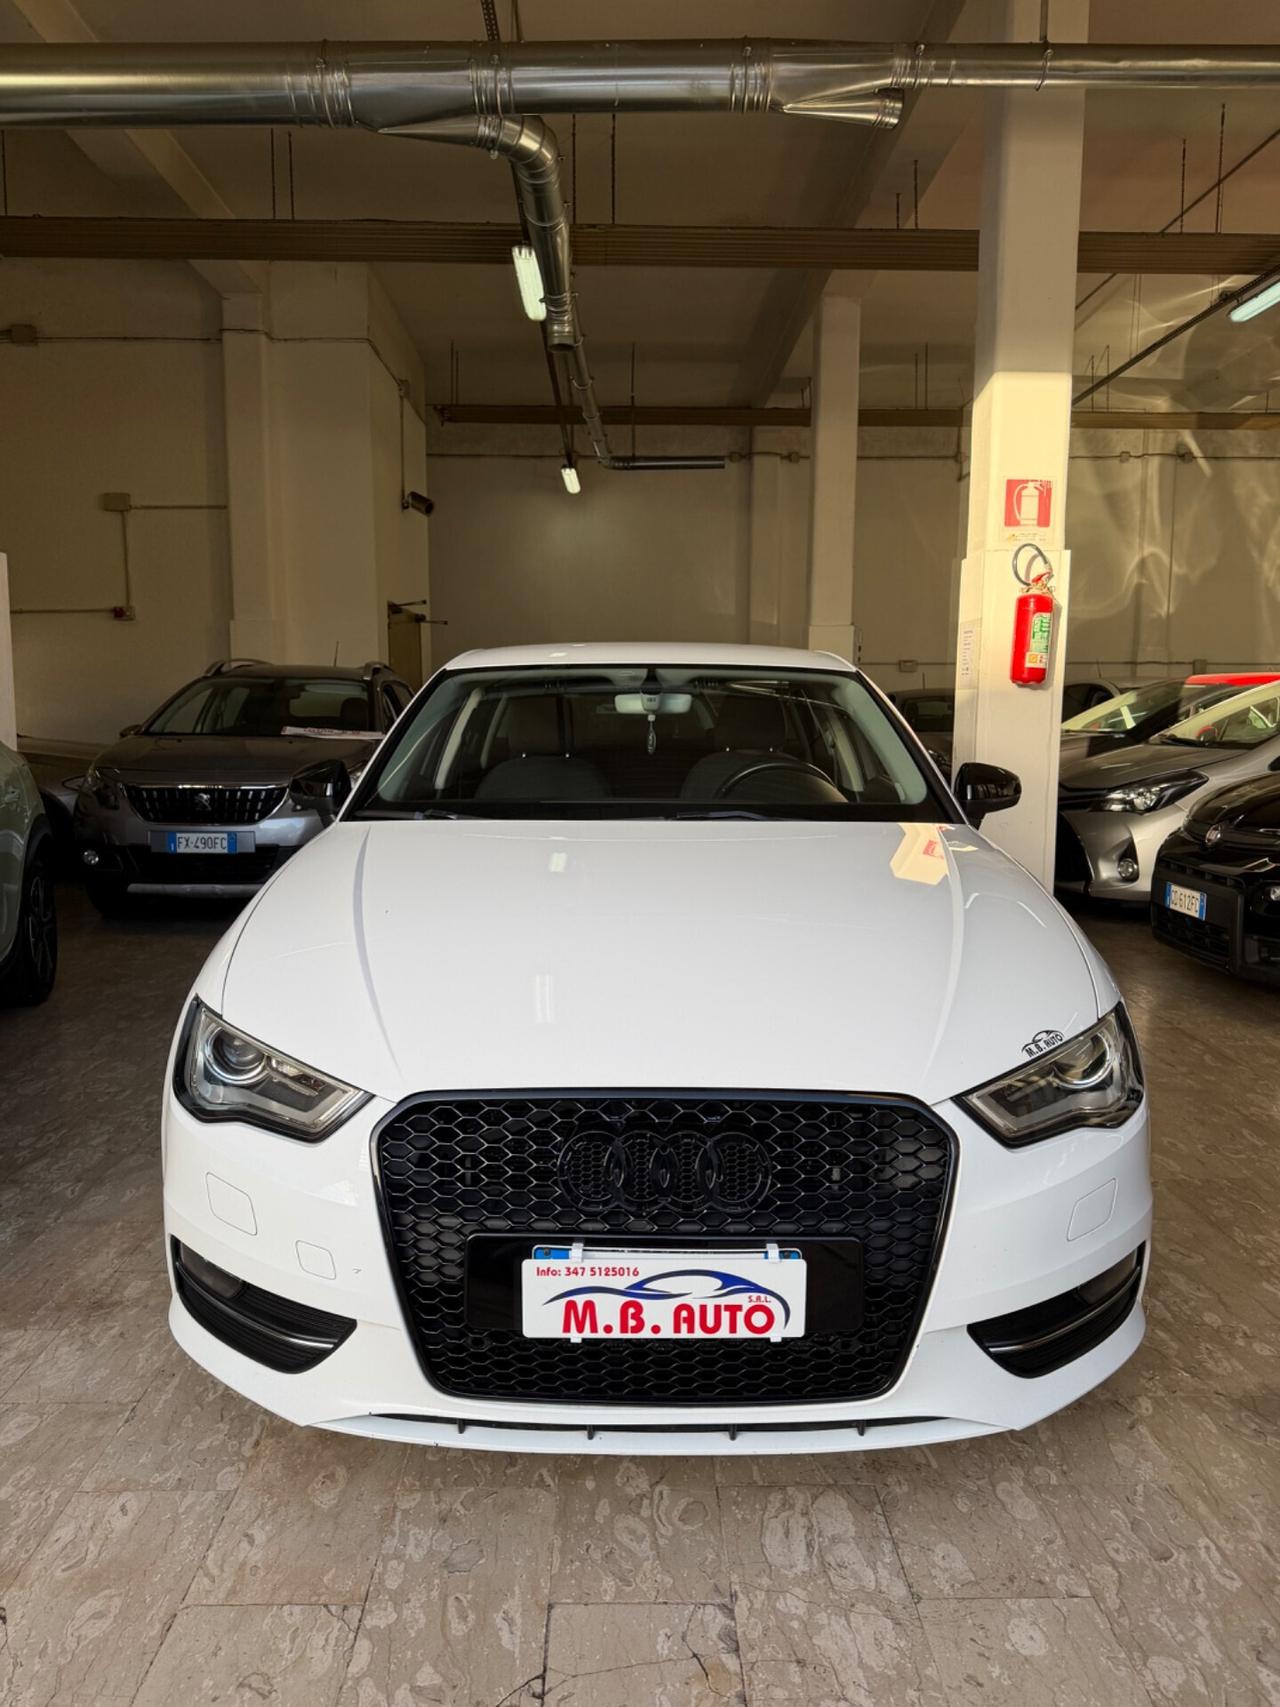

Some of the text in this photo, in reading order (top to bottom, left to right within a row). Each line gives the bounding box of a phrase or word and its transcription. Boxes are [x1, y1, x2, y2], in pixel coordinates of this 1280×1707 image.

[1043, 1034, 1063, 1049] AUTO
[536, 1266, 640, 1277] Info: 347 5125016
[673, 1303, 775, 1334] AUTO
